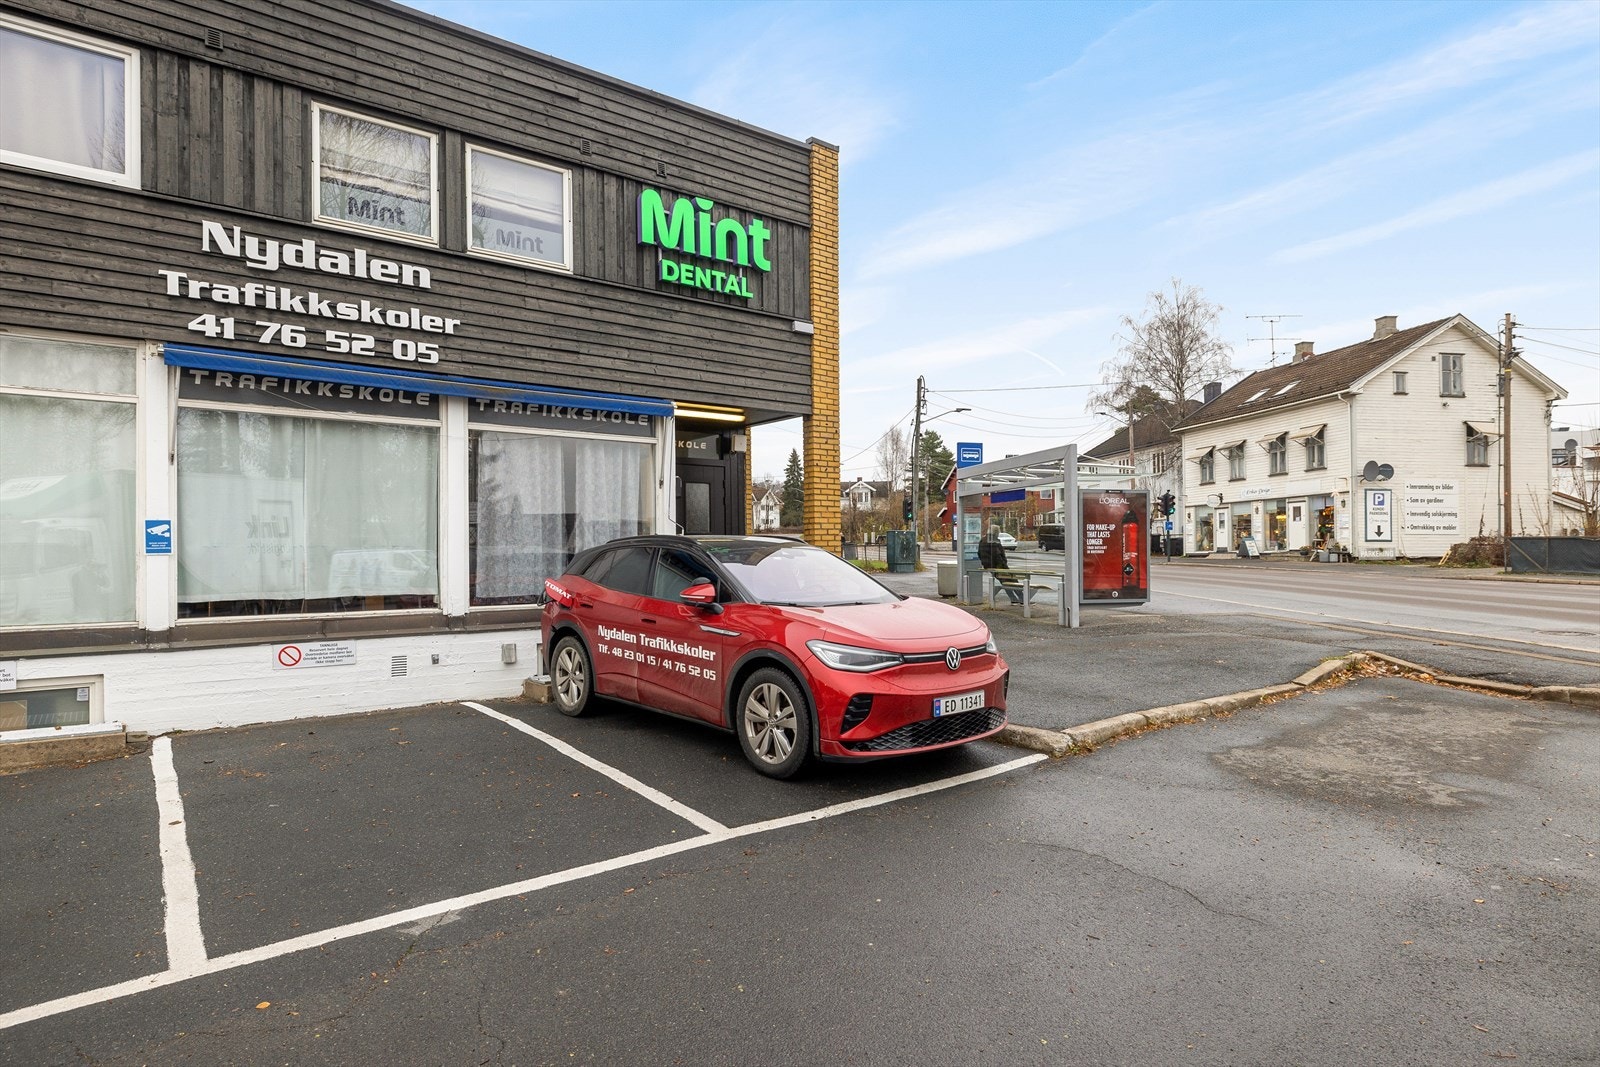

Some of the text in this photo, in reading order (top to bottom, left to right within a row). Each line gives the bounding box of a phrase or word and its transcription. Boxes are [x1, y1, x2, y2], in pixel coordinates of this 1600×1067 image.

[348, 197, 405, 225] Mint
[496, 228, 544, 254] Mint
[638, 188, 771, 272] Mint
[202, 220, 431, 288] Nydalen
[660, 259, 753, 298] DENTAL
[158, 269, 460, 334] Trafikkskoler
[188, 313, 440, 364] 41 76 52 05
[189, 369, 430, 406] TRAFIKKSKOLE
[476, 399, 649, 426] TRAFIKKSKOLE
[598, 625, 716, 661] Nydalen Trafikkskoler
[598, 643, 611, 654] Tlf.
[612, 647, 622, 657] 48
[624, 649, 634, 660] 23
[636, 653, 645, 662] 01
[647, 655, 656, 666] 15
[663, 659, 672, 670] 41
[675, 661, 686, 673] 76
[689, 665, 701, 677] 52
[703, 668, 716, 680] 05
[945, 695, 981, 713] ED 11341
